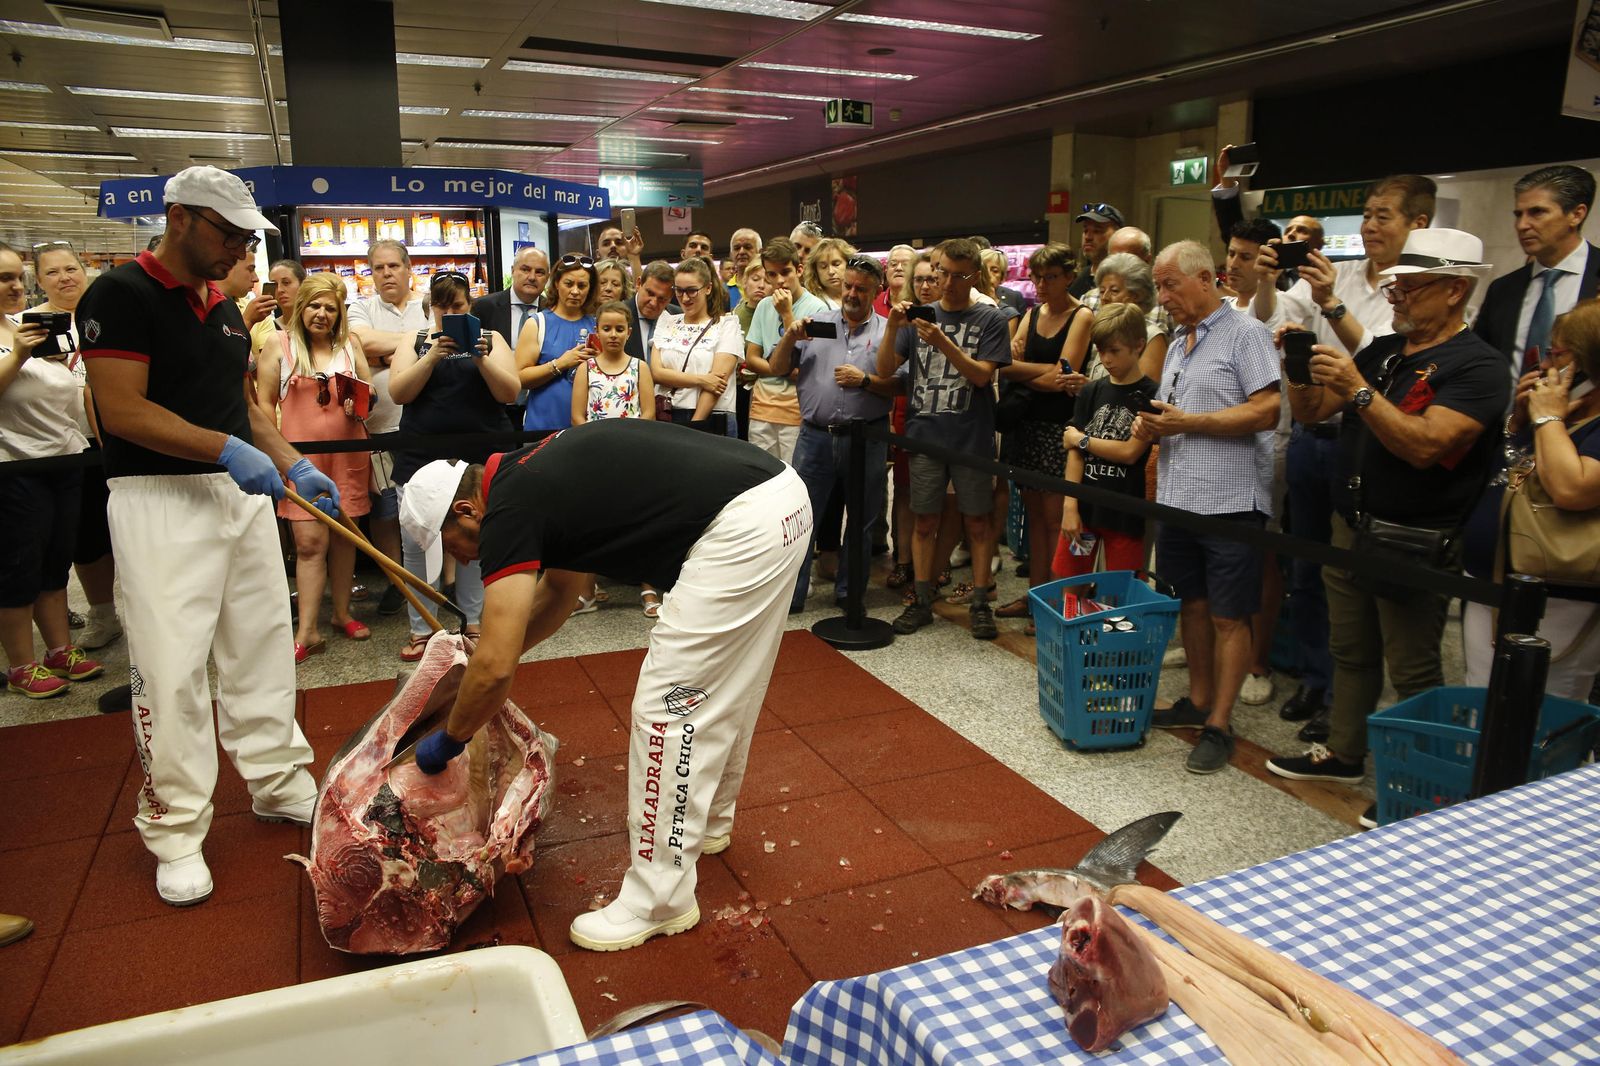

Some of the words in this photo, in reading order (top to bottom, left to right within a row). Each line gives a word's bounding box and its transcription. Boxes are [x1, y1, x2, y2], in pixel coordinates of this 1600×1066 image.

[128, 189, 152, 203] en
[391, 175, 425, 192] Lo
[444, 177, 513, 198] mejor
[523, 184, 546, 199] del
[554, 190, 580, 204] mar
[588, 194, 603, 210] ya
[1264, 194, 1285, 213] LA
[1085, 463, 1127, 480] QUEEN
[676, 723, 695, 777] CHICO
[638, 722, 668, 862] ALMADRABA
[669, 783, 689, 850] PETACA
[674, 855, 682, 867] DE
